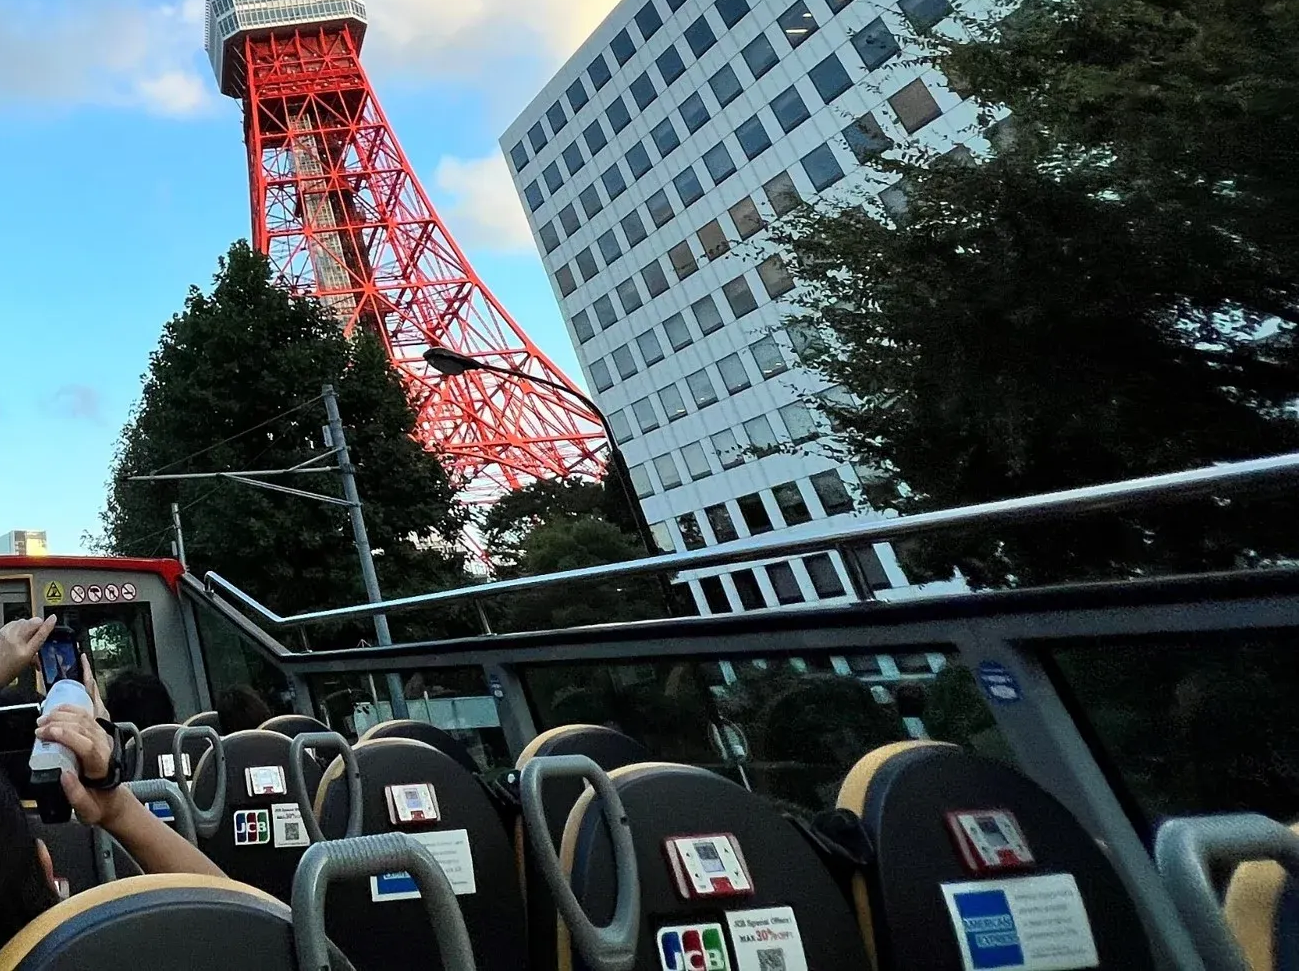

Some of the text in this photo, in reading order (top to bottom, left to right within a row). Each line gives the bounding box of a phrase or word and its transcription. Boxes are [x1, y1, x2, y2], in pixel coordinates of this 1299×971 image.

[236, 821, 267, 834] JCB
[739, 934, 756, 943] MAX
[663, 948, 726, 971] JCB
